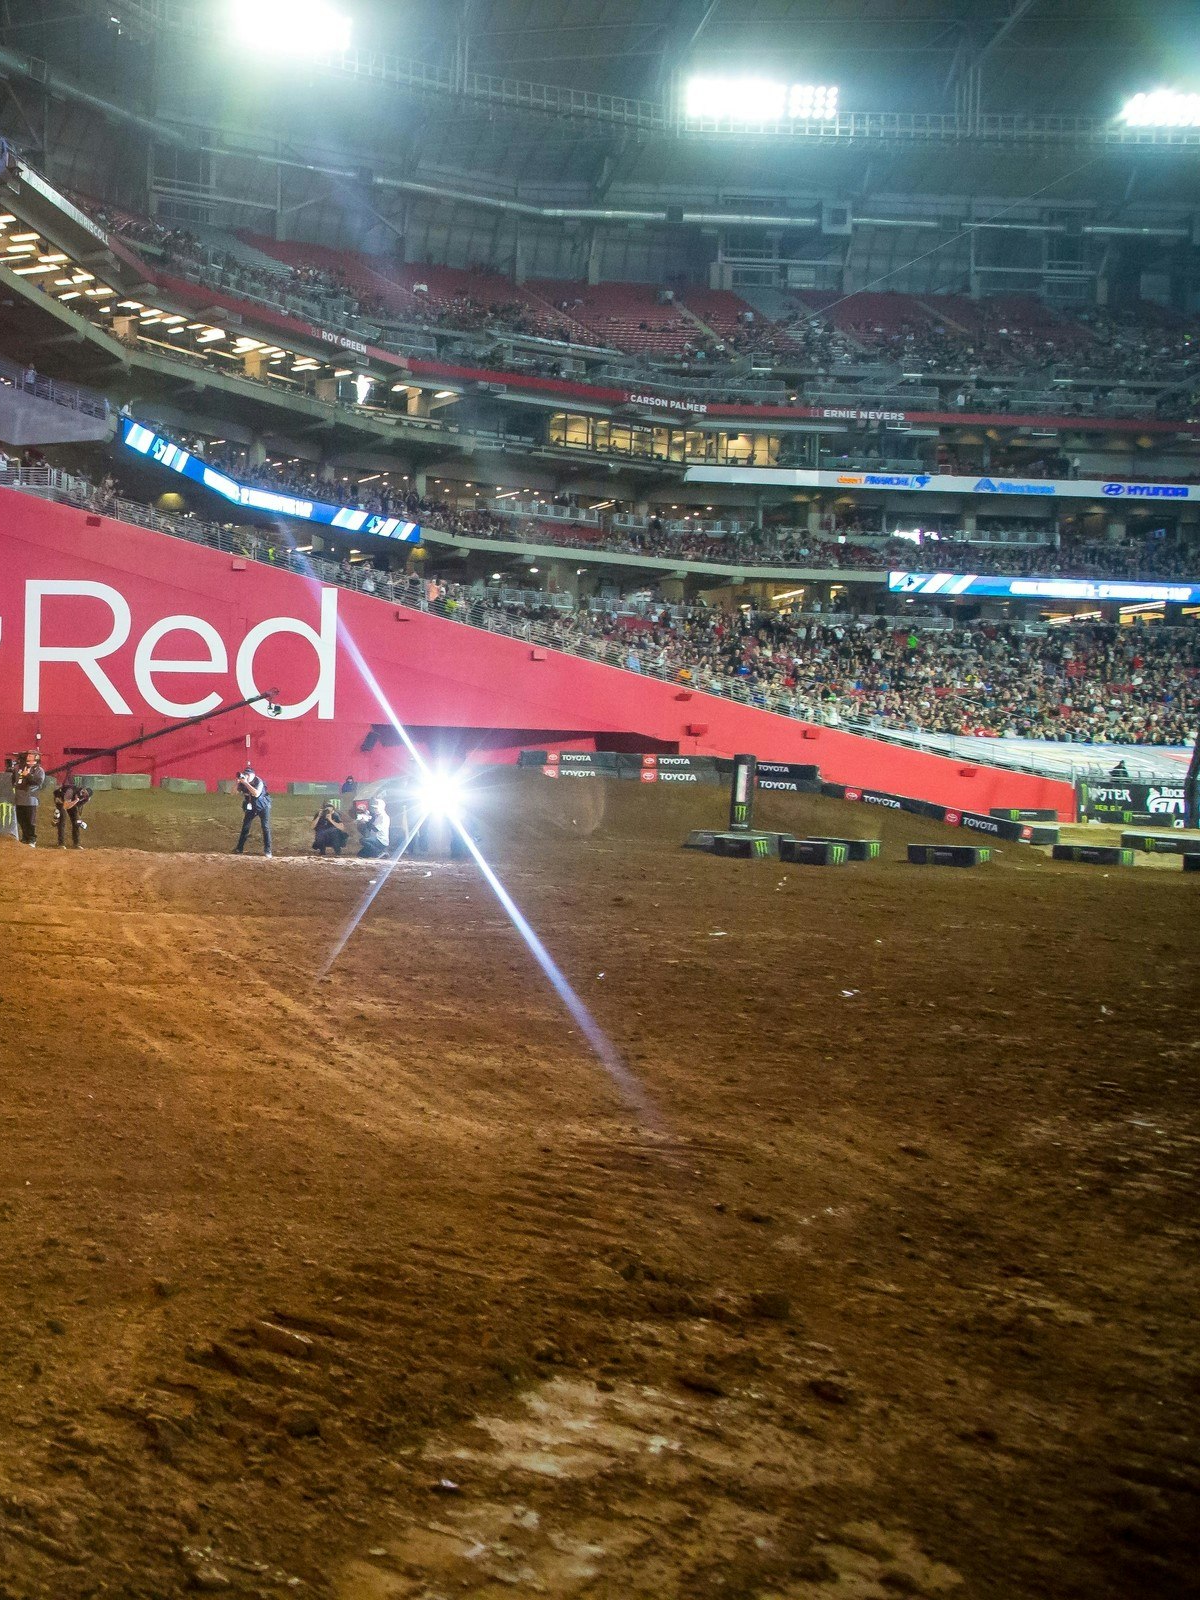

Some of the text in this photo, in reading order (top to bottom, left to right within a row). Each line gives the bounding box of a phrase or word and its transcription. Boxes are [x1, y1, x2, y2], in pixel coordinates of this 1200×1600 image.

[321, 330, 339, 344] ROY
[340, 337, 367, 354] GREEN
[630, 394, 668, 408] CARSON
[670, 400, 707, 413] PALMER
[823, 409, 857, 419] ERNIE
[859, 411, 905, 421] NEVERS
[22, 578, 339, 721] Red
[562, 754, 592, 762] TOYOTA
[659, 757, 690, 766] TOYOTA
[757, 763, 790, 774] TOYOTA
[659, 772, 697, 782] TOYOTA
[759, 780, 798, 791] TOYOTA
[863, 794, 901, 809] TOYOTA
[962, 816, 999, 833] TOYOTA
